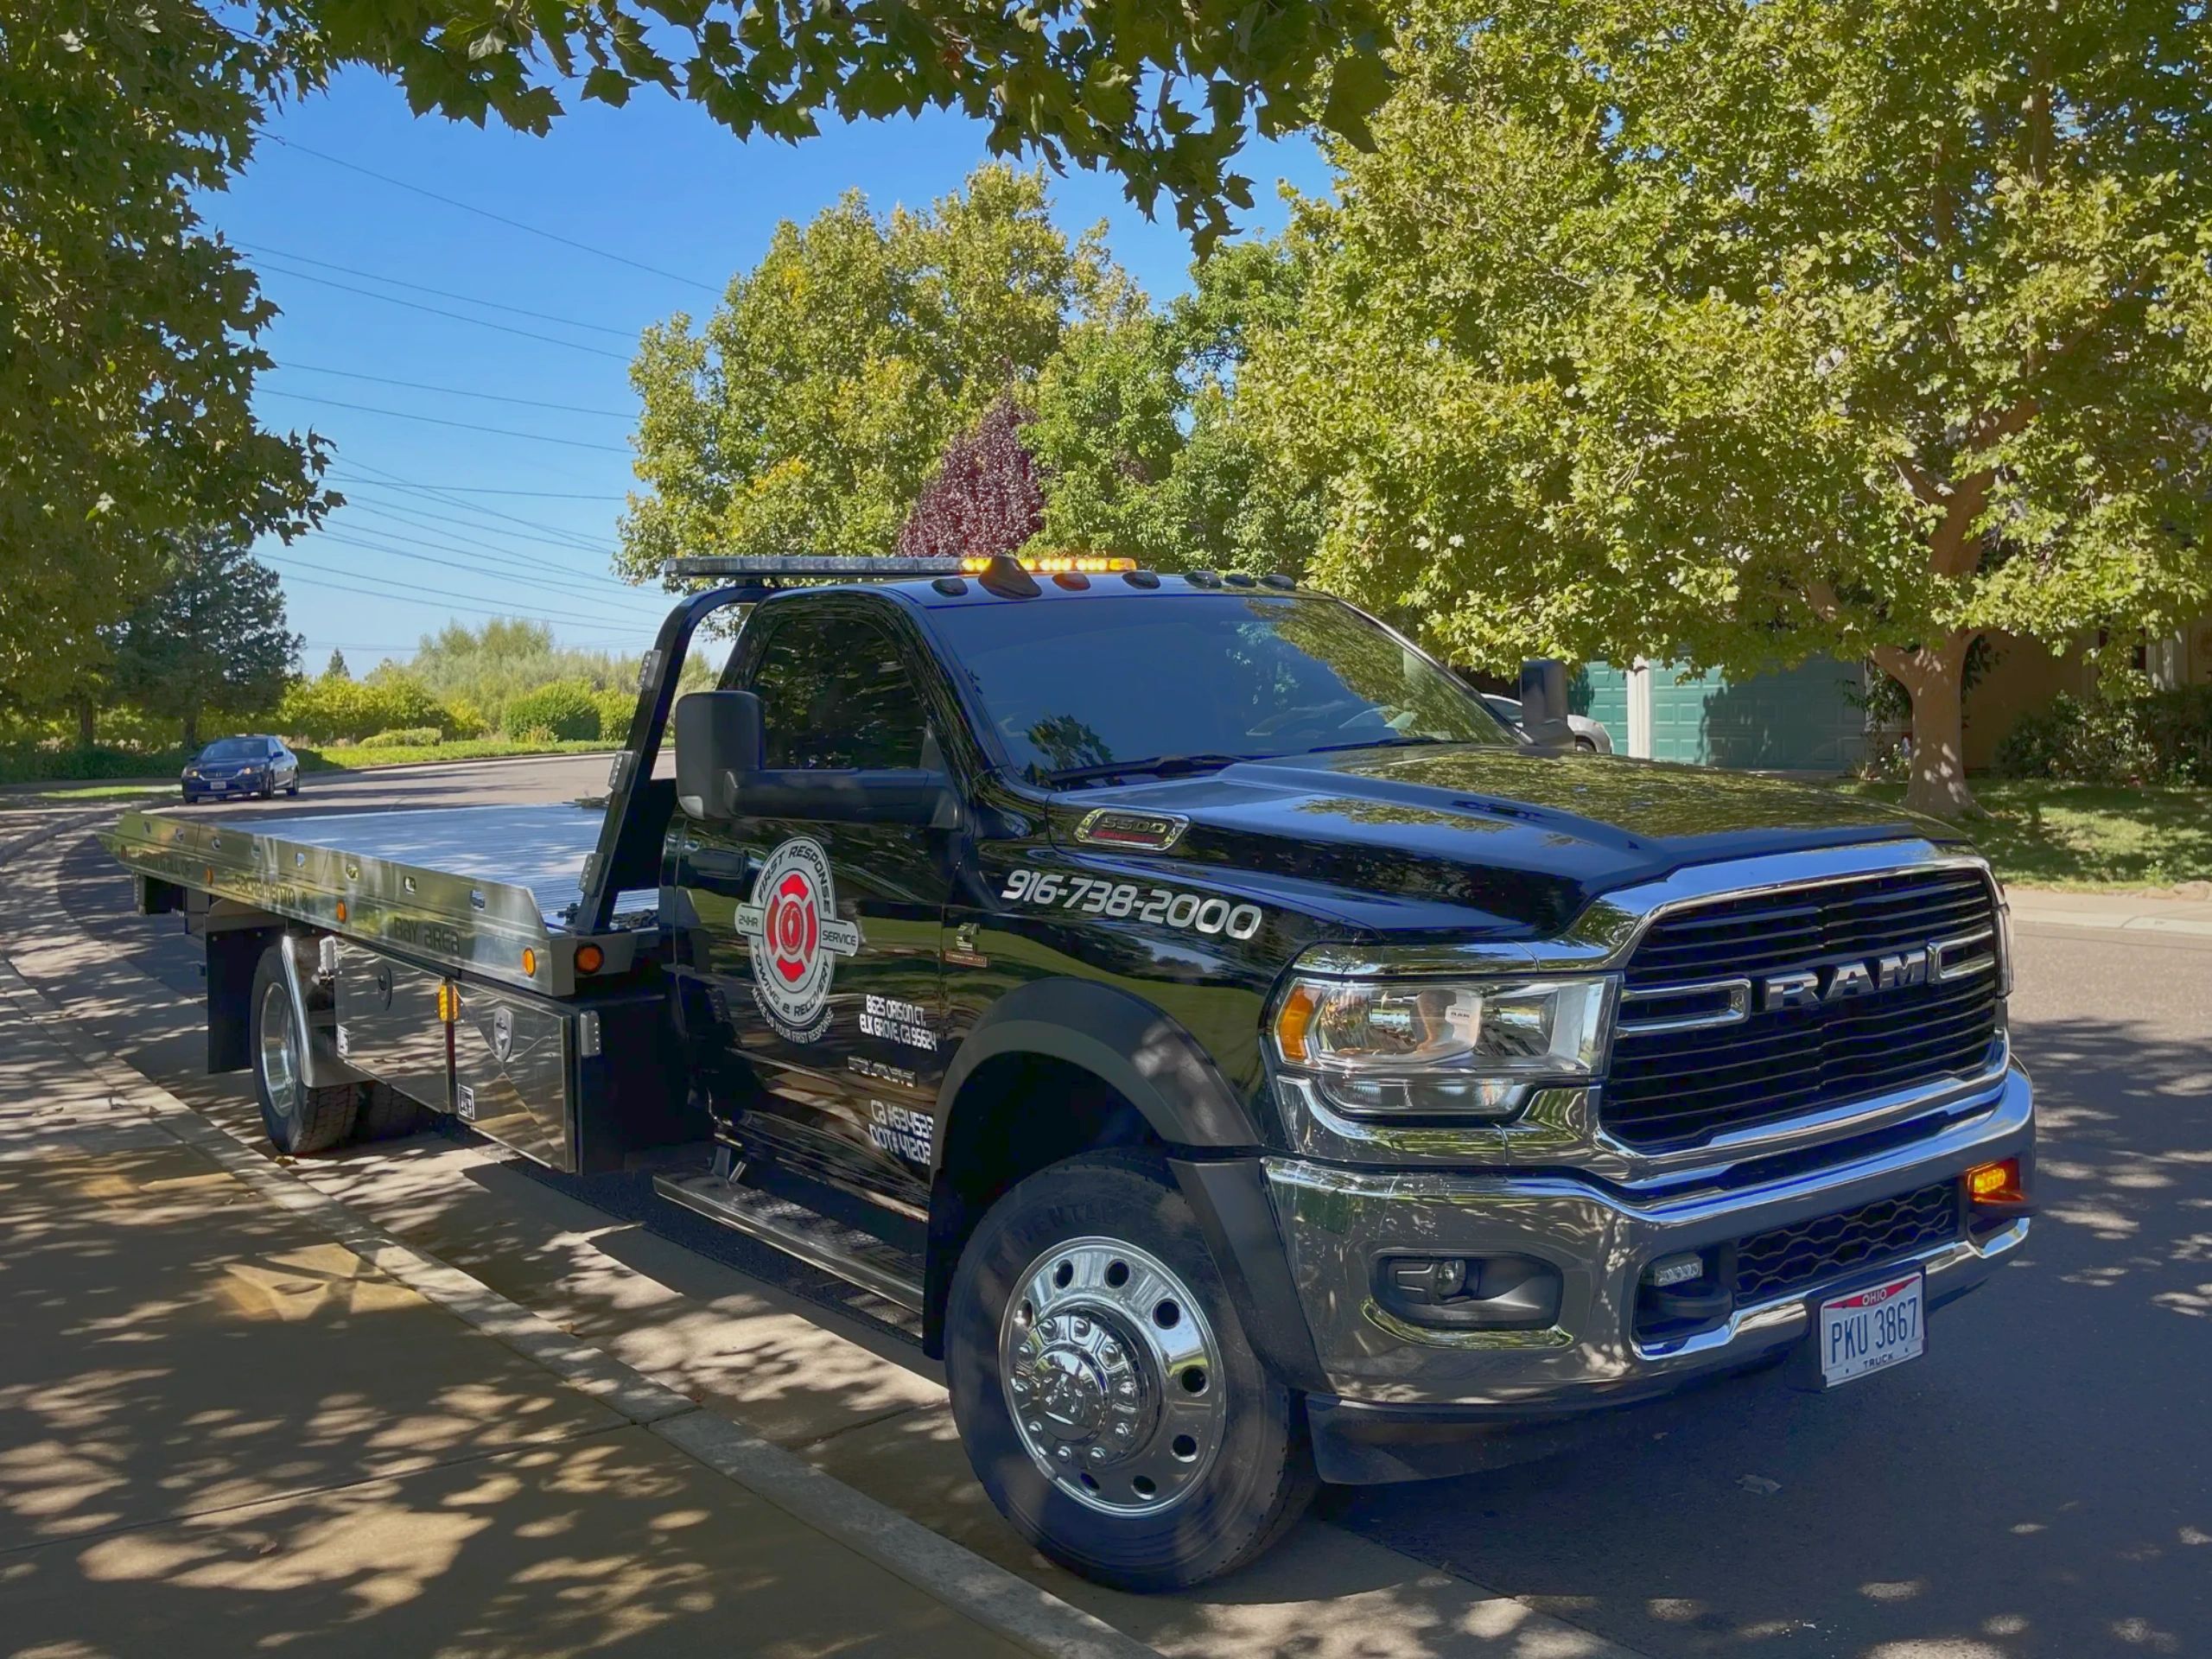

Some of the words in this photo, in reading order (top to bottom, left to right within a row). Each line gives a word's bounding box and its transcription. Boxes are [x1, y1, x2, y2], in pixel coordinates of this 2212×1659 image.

[1101, 817, 1167, 835] 5500
[758, 850, 785, 903] FIRST
[788, 846, 830, 914] RESPONSE
[1001, 869, 1262, 940] 916-738-2000
[739, 914, 759, 927] 24HR
[823, 930, 857, 947] SERVICE
[754, 943, 781, 1005] TOWING
[793, 954, 830, 1017] RECOVERY
[1765, 950, 1927, 1011] RAM
[751, 986, 767, 1017] MAKE
[775, 1020, 791, 1042] YOUR
[791, 1031, 809, 1045] FIRST
[807, 1006, 836, 1043] RESPONSE
[867, 995, 886, 1017] 8625
[859, 1014, 874, 1035] ELK
[912, 1027, 938, 1052] 95624
[1861, 1288, 1887, 1306] OHIO
[1831, 1313, 1868, 1364] PKU
[1874, 1296, 1917, 1349] 3867
[1863, 1352, 1894, 1370] TRUCK
